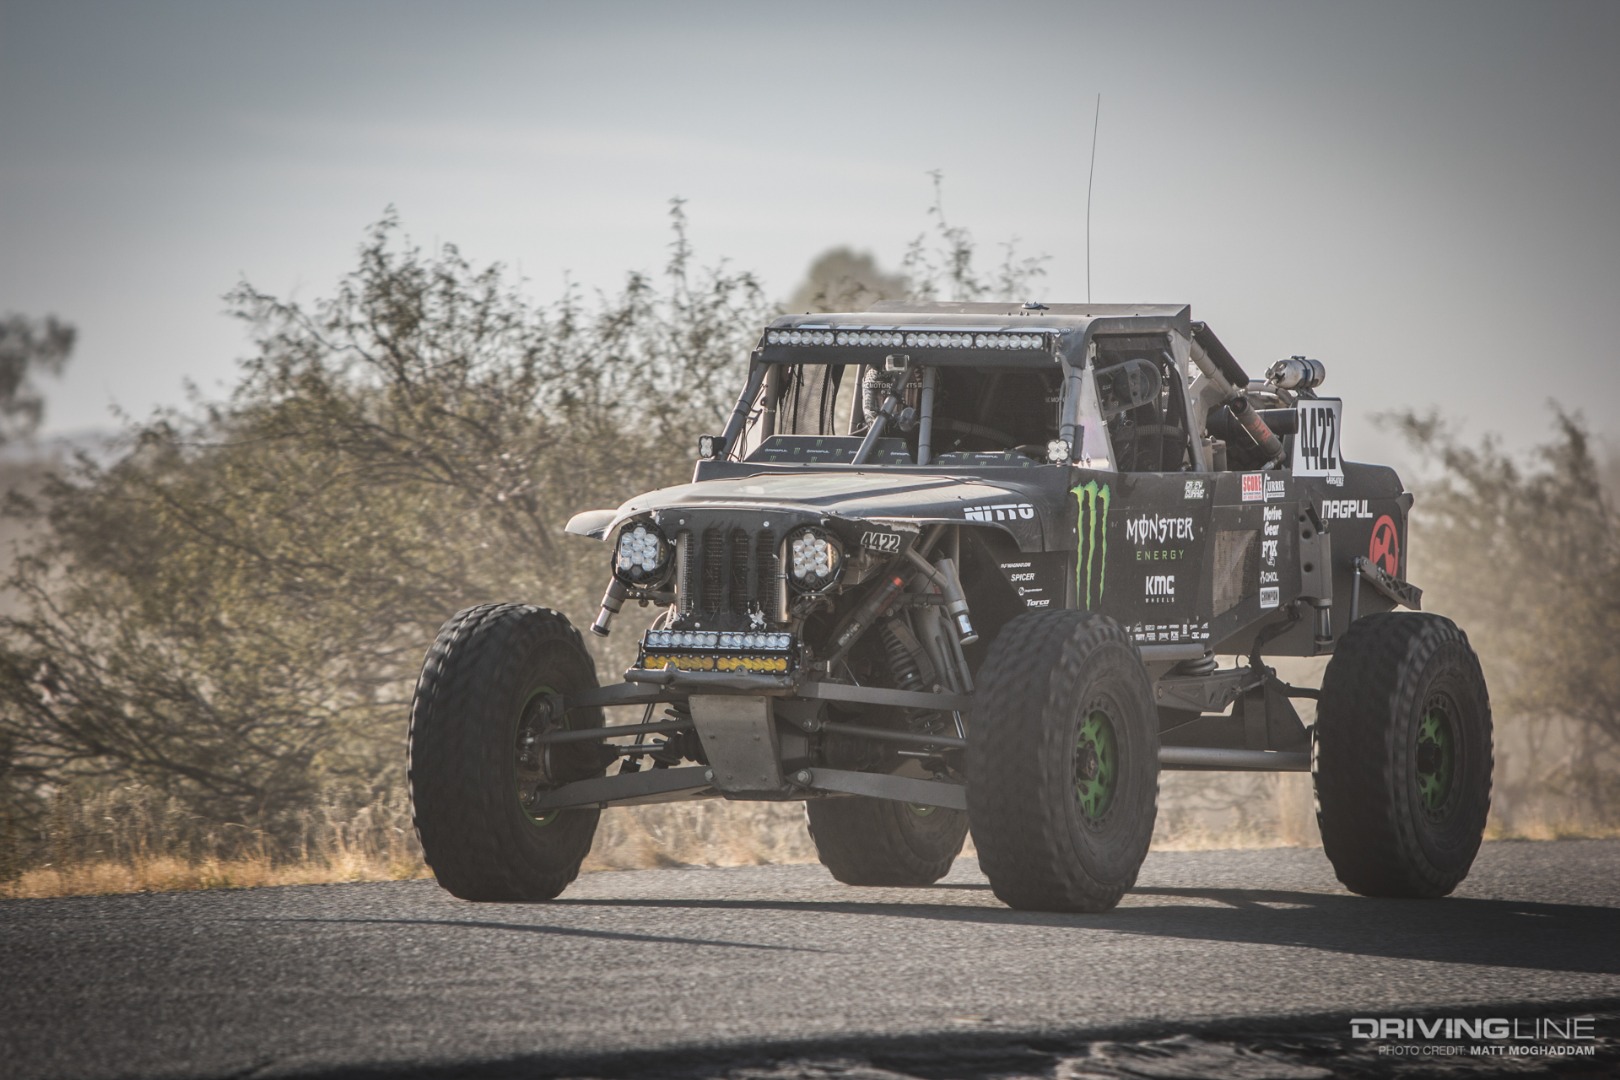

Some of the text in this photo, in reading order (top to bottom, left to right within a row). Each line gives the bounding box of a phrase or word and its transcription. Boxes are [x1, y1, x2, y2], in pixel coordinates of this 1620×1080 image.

[1299, 407, 1337, 471] 4422
[1243, 475, 1262, 492] SCORE
[1263, 473, 1285, 502] CURRIE
[963, 503, 1034, 522] NITTO
[1263, 505, 1283, 521] Motive
[1321, 500, 1374, 519] MAGPUL
[1126, 513, 1195, 545] MONSTER
[1264, 521, 1280, 536] Gear
[861, 531, 901, 553] 4422
[1136, 549, 1184, 561] ENERGY
[1011, 572, 1035, 581] SPICER
[1145, 575, 1175, 595] KMC
[1026, 599, 1050, 607] Torco
